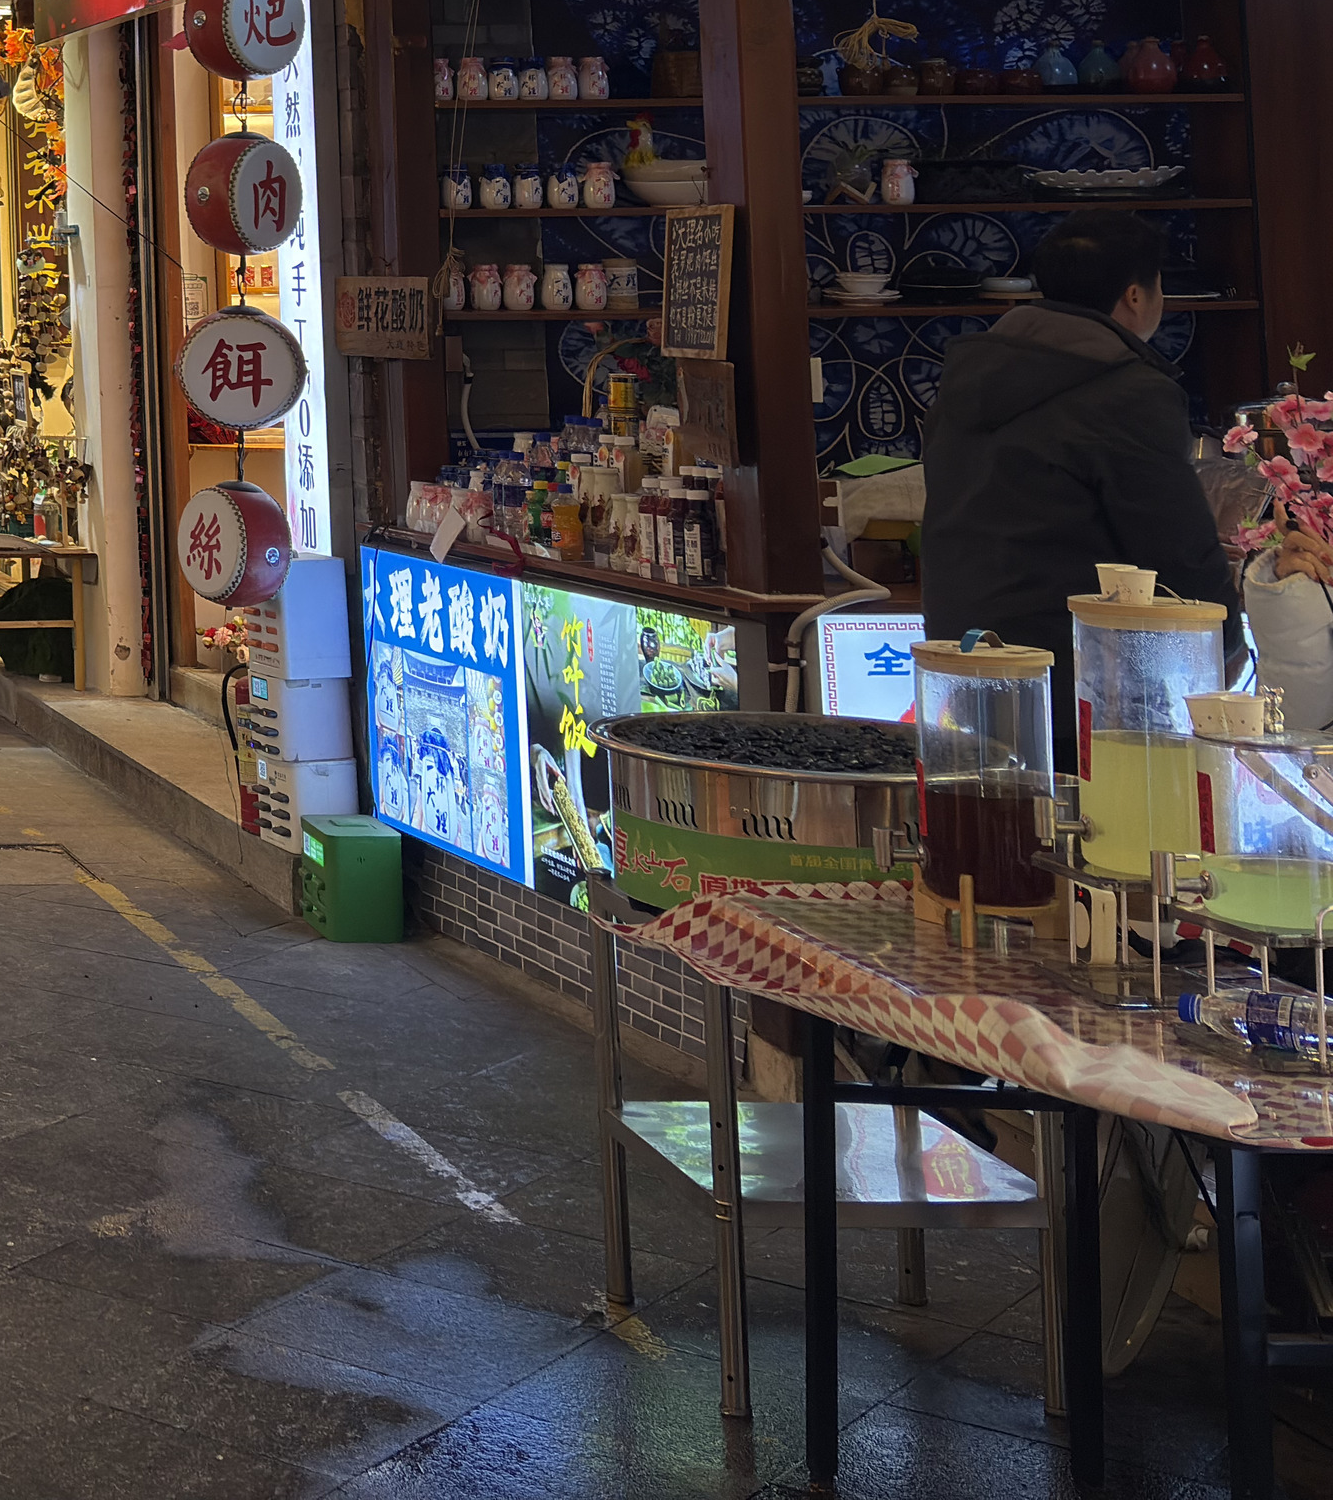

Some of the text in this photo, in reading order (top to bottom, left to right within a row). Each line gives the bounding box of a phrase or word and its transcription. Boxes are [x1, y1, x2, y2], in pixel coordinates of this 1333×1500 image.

[251, 160, 288, 233] 肉
[357, 286, 425, 334] 鲜花酸奶
[365, 558, 511, 669] 大理老酸奶
[560, 613, 598, 759] 竹叶饭
[863, 642, 911, 678] 全
